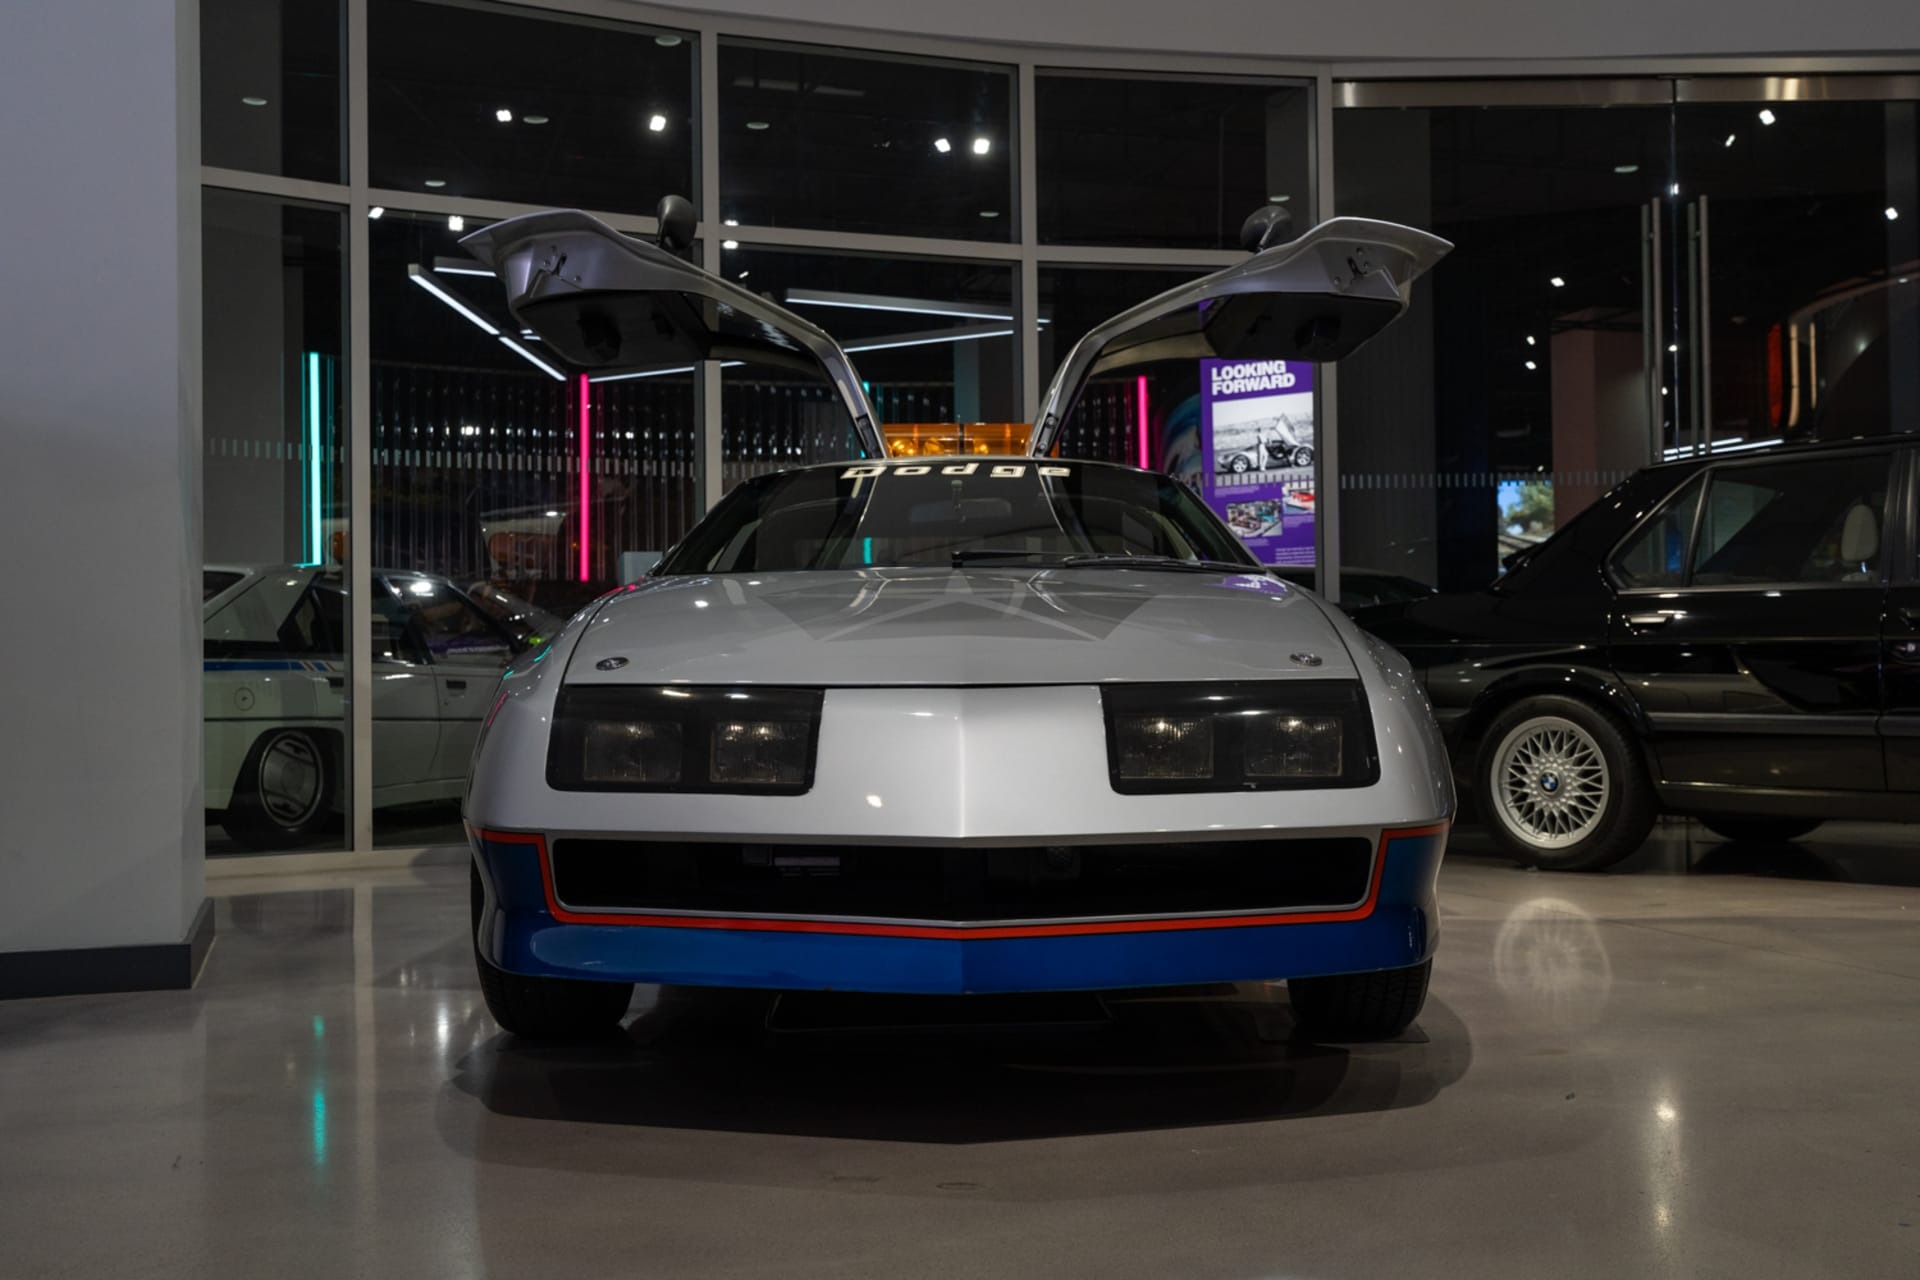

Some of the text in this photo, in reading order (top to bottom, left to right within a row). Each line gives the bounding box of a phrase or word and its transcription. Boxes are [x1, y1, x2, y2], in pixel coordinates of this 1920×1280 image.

[1211, 360, 1286, 381] LOOKING
[1212, 373, 1296, 396] FORWARD
[840, 463, 1071, 479] Dodge
